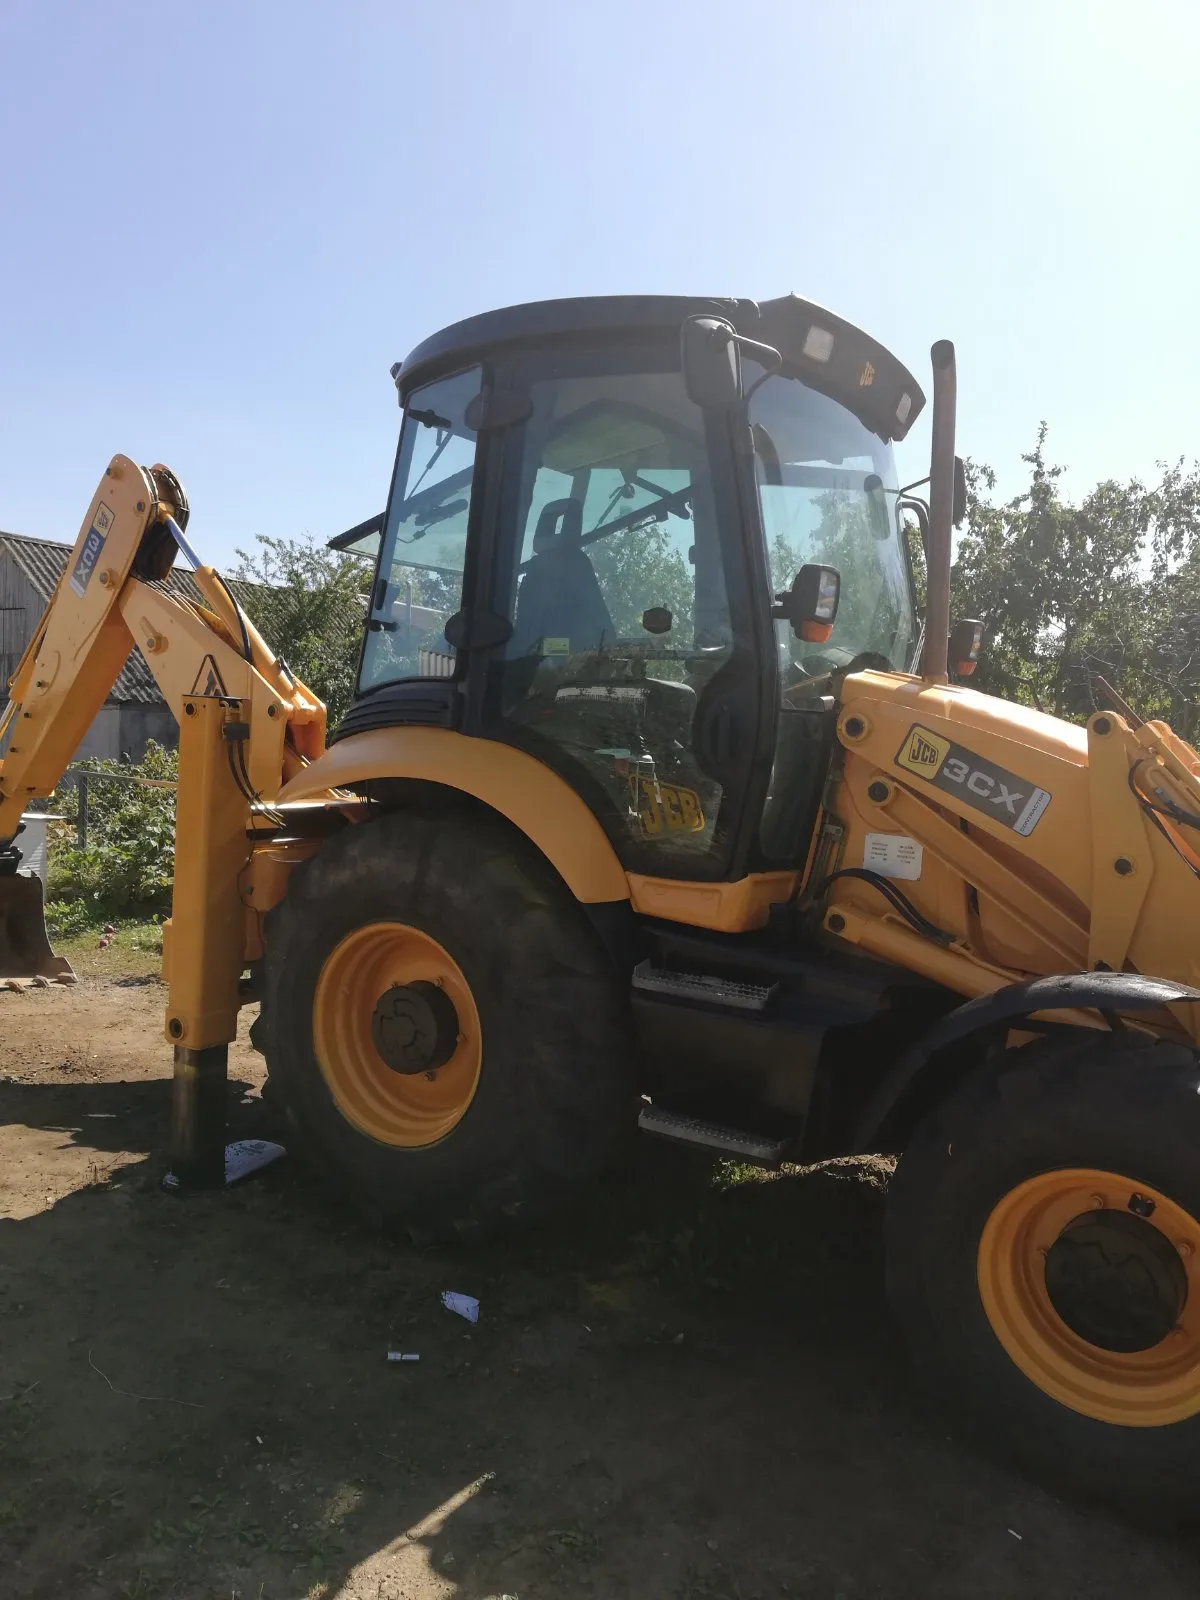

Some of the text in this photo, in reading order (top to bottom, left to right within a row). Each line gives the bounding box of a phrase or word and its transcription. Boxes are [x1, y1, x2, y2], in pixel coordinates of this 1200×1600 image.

[76, 534, 99, 581] 3CX
[911, 737, 937, 764] JCB
[642, 781, 699, 833] JCB
[943, 758, 1025, 814] 3CX
[1020, 792, 1044, 832] CONTRACTOR
